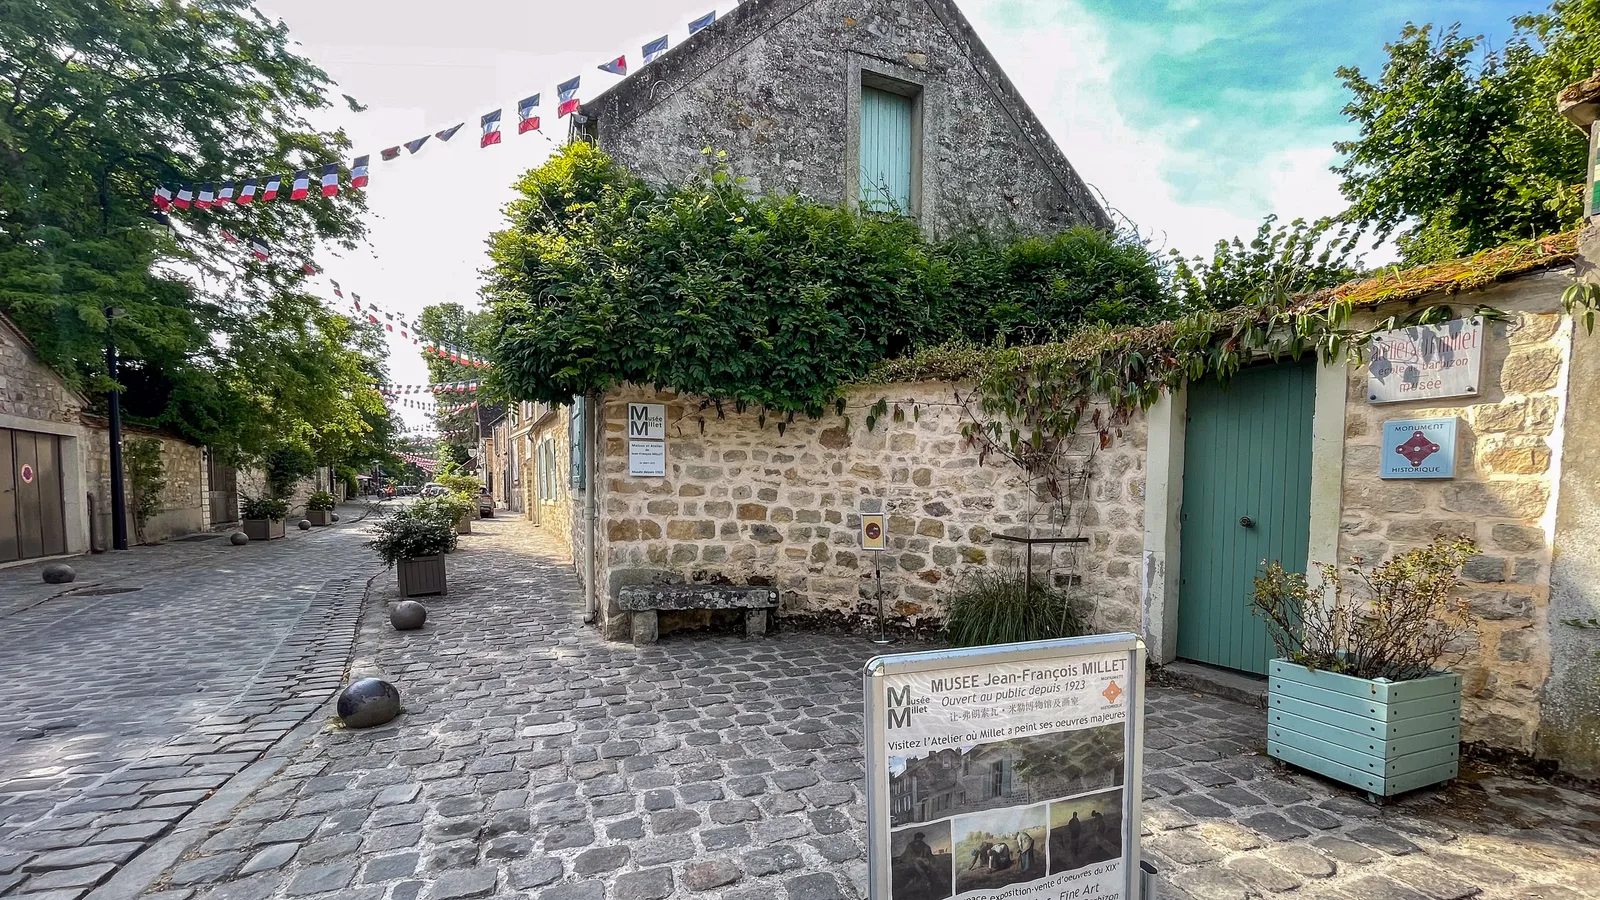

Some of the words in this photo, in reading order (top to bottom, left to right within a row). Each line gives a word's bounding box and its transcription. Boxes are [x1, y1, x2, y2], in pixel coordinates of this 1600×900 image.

[631, 405, 663, 421] Musée
[630, 421, 662, 436] Millet
[1394, 424, 1444, 432] MONUMENT
[931, 674, 980, 693] MUSEE
[984, 665, 1078, 687] Jean-François
[1082, 658, 1127, 676] MILLET
[886, 685, 931, 708] Musée
[941, 693, 977, 707] Ouvert
[980, 694, 993, 702] au
[995, 687, 1027, 703] public
[1028, 684, 1061, 697] depuis
[1064, 680, 1086, 692] 1923
[887, 705, 928, 730] Millet
[888, 740, 921, 751] Visitez
[924, 733, 964, 747] l'Atelier
[966, 731, 978, 741] où
[979, 727, 1005, 739] Millet
[1007, 726, 1013, 735] a
[1014, 722, 1037, 736] peint
[1039, 721, 1053, 730] ses
[1055, 717, 1089, 727] oeuvres
[1090, 710, 1126, 723] majeures
[1056, 869, 1092, 886] d'oeuvres
[1094, 866, 1104, 876] du
[1060, 888, 1080, 900] Fine
[1082, 883, 1100, 895] Art
